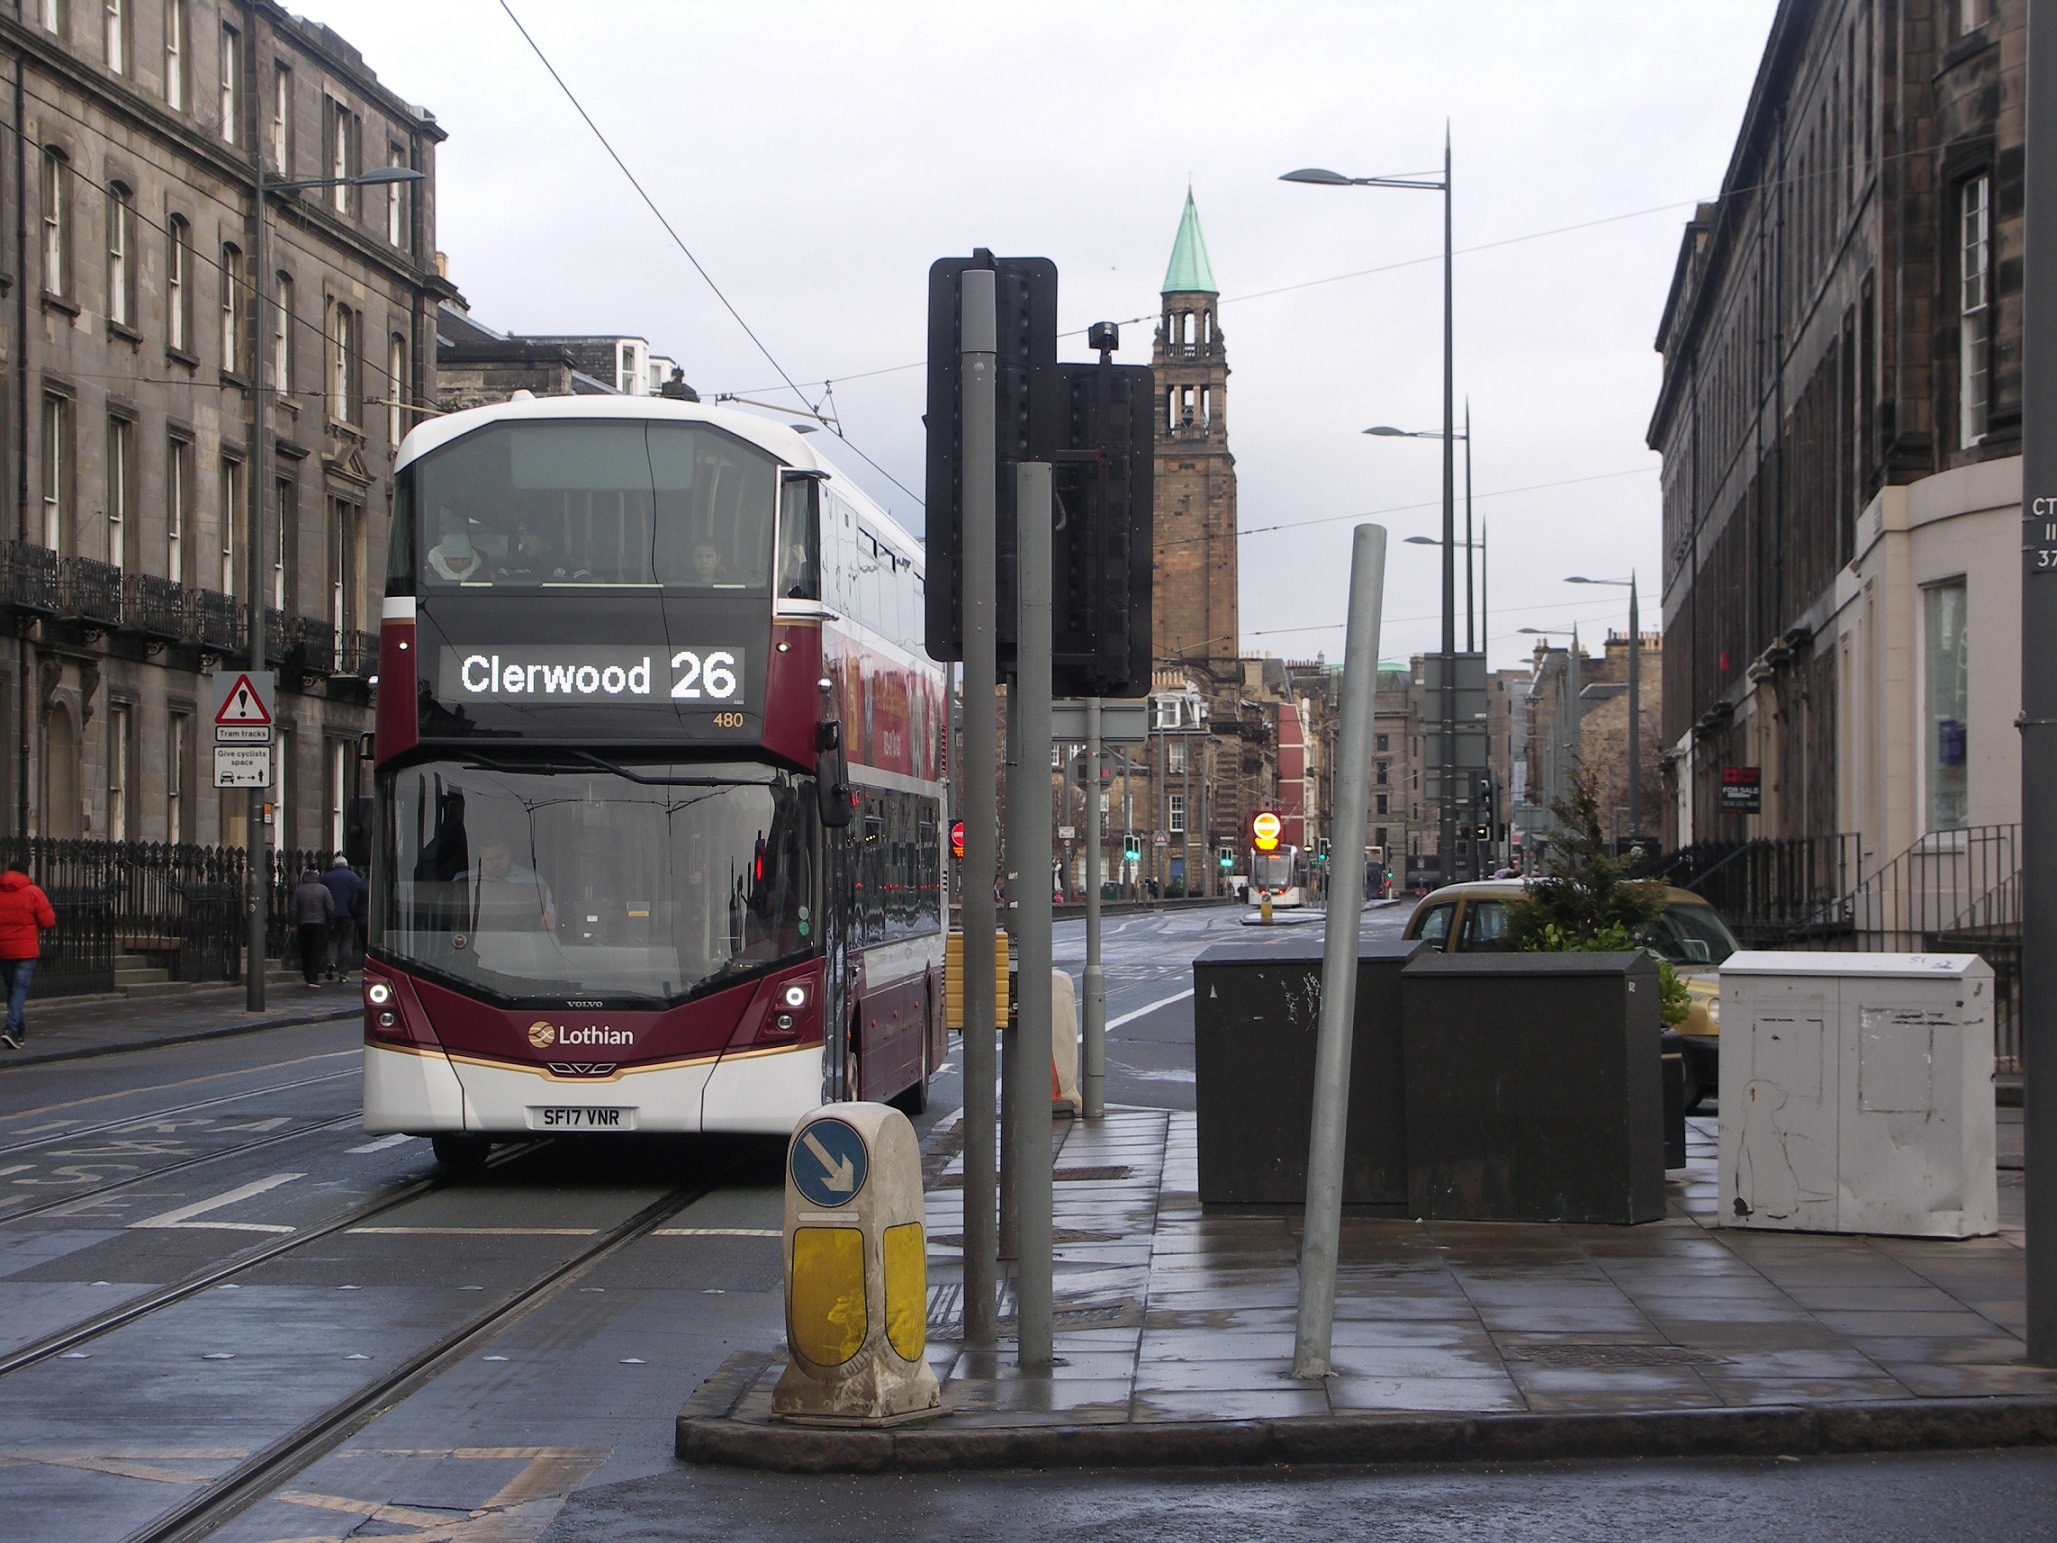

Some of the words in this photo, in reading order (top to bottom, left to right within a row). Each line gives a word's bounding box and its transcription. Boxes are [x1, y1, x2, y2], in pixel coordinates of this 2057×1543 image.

[461, 654, 650, 694] Clerwood
[670, 651, 736, 698] 26
[713, 712, 743, 727] 480
[217, 750, 236, 758] Give
[237, 750, 267, 759] cyclists
[231, 759, 254, 767] space
[1722, 786, 1739, 794] FOR
[1740, 787, 1759, 795] SALE
[559, 1025, 634, 1045] Lothian
[544, 1109, 581, 1126] SF17
[586, 1109, 620, 1126] VNR
